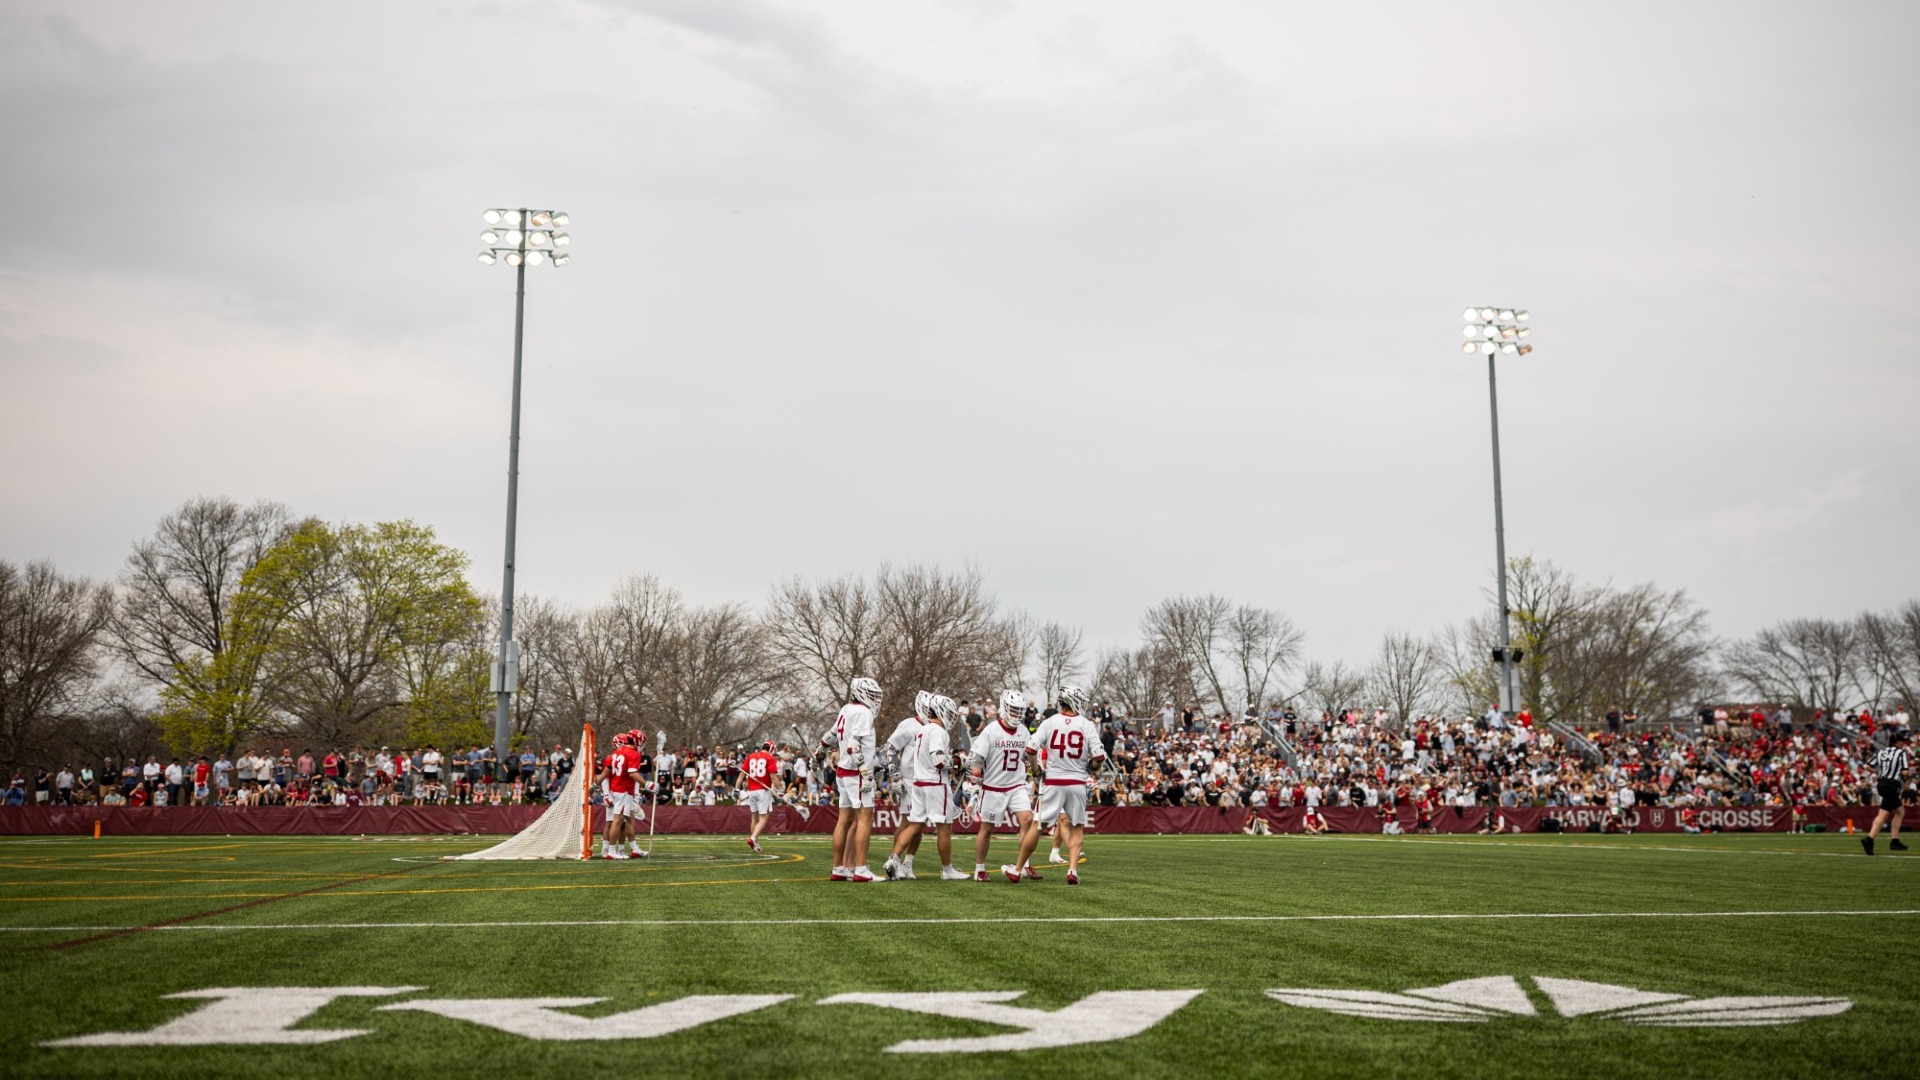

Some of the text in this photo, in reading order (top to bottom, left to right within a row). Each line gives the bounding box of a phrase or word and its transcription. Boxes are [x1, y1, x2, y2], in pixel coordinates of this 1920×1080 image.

[837, 714, 846, 741] 4
[1050, 729, 1084, 759] 49
[749, 758, 767, 778] 88
[1002, 749, 1020, 772] 13
[1674, 810, 1775, 828] LCROSSE
